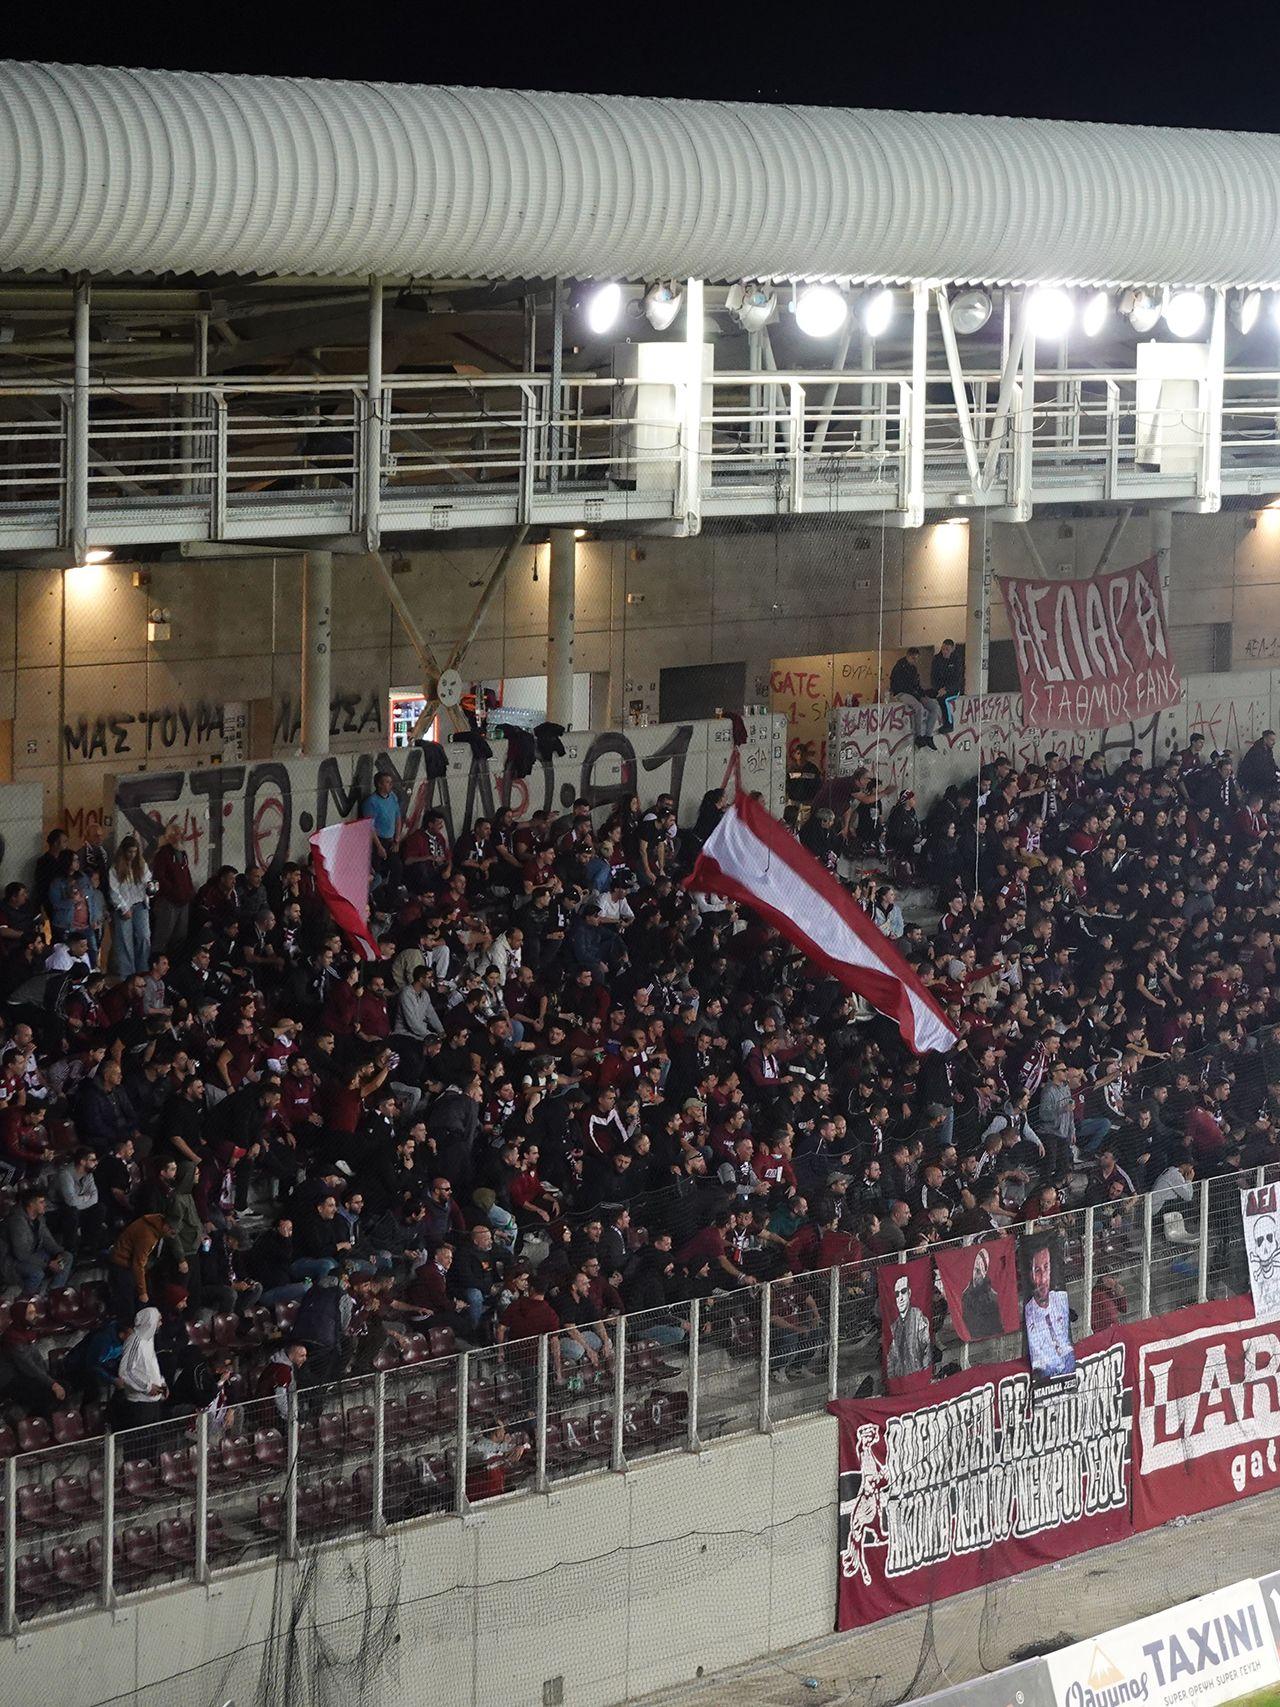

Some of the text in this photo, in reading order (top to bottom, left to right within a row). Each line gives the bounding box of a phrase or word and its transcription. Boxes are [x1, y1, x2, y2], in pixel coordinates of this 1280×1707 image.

[1143, 1604, 1264, 1687] TAXINI
[1164, 1687, 1187, 1706] SUPER
[1216, 1669, 1239, 1687] SUPER
